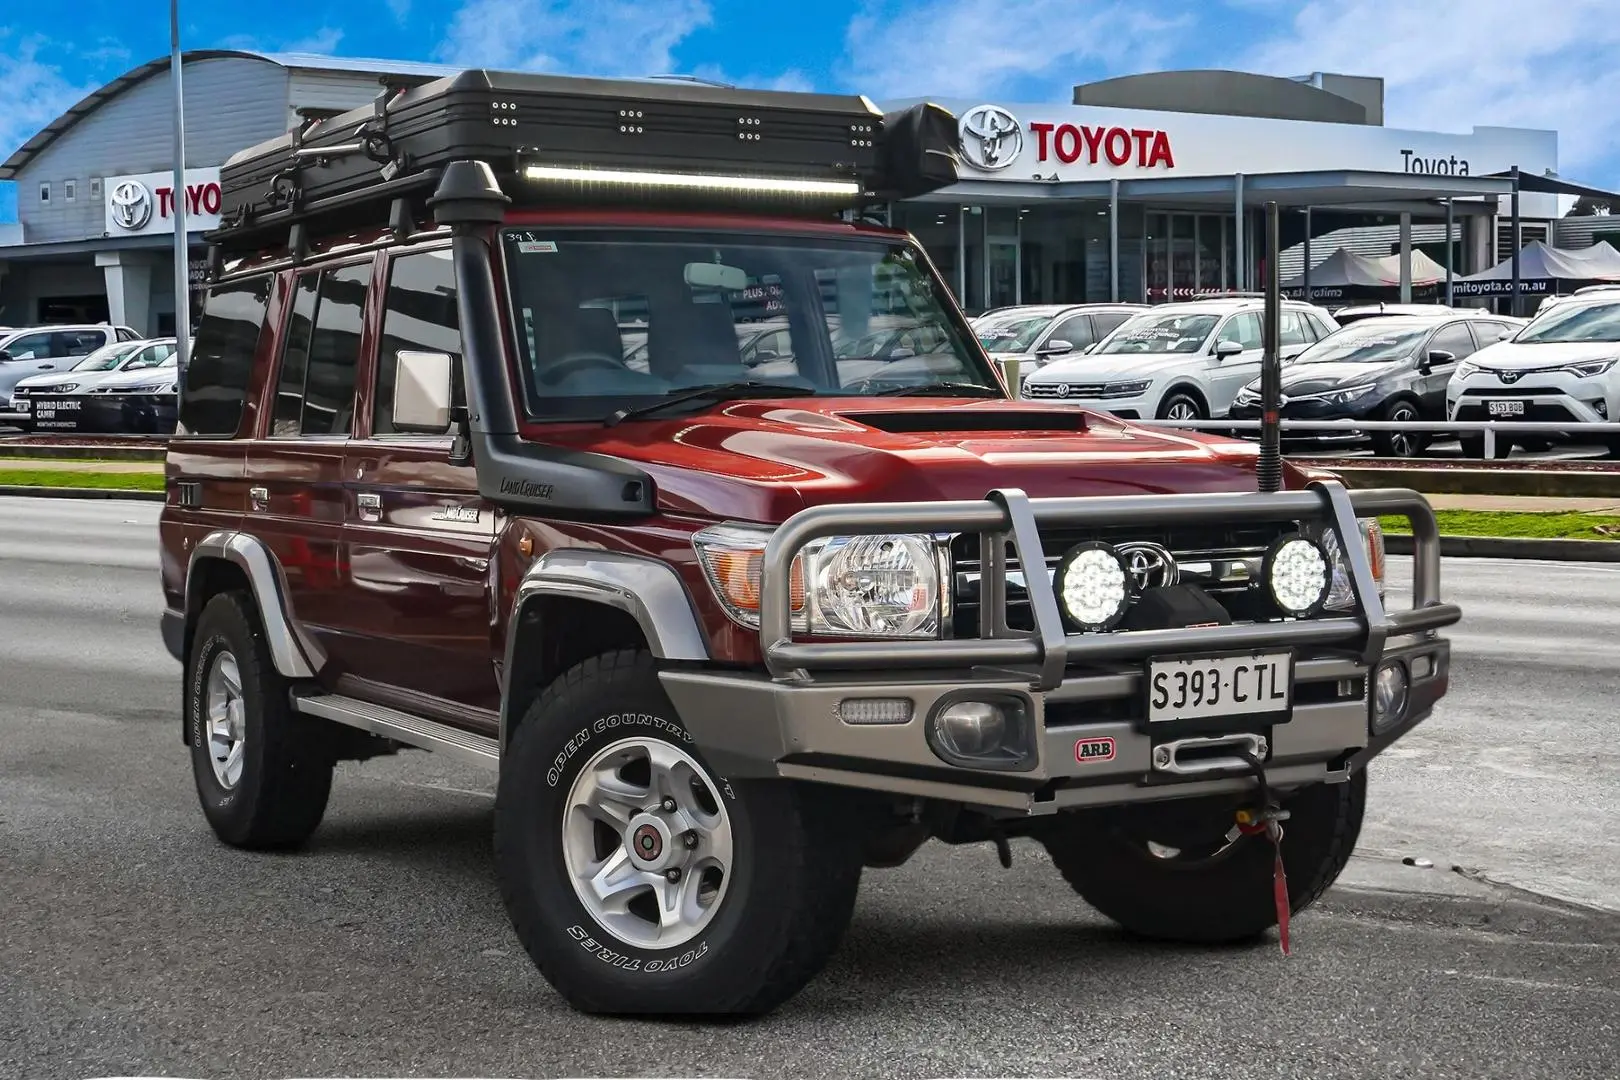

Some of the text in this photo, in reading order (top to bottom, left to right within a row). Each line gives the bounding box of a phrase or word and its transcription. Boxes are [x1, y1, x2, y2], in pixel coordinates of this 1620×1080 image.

[1030, 122, 1174, 168] TOYOTA
[1400, 149, 1469, 176] Toyota
[57, 401, 81, 409] ELECTRIC
[546, 728, 590, 787] OPEN
[593, 713, 695, 744] COUNTRY
[1080, 742, 1111, 757] ARB
[566, 925, 708, 973] TOYO TIRES
